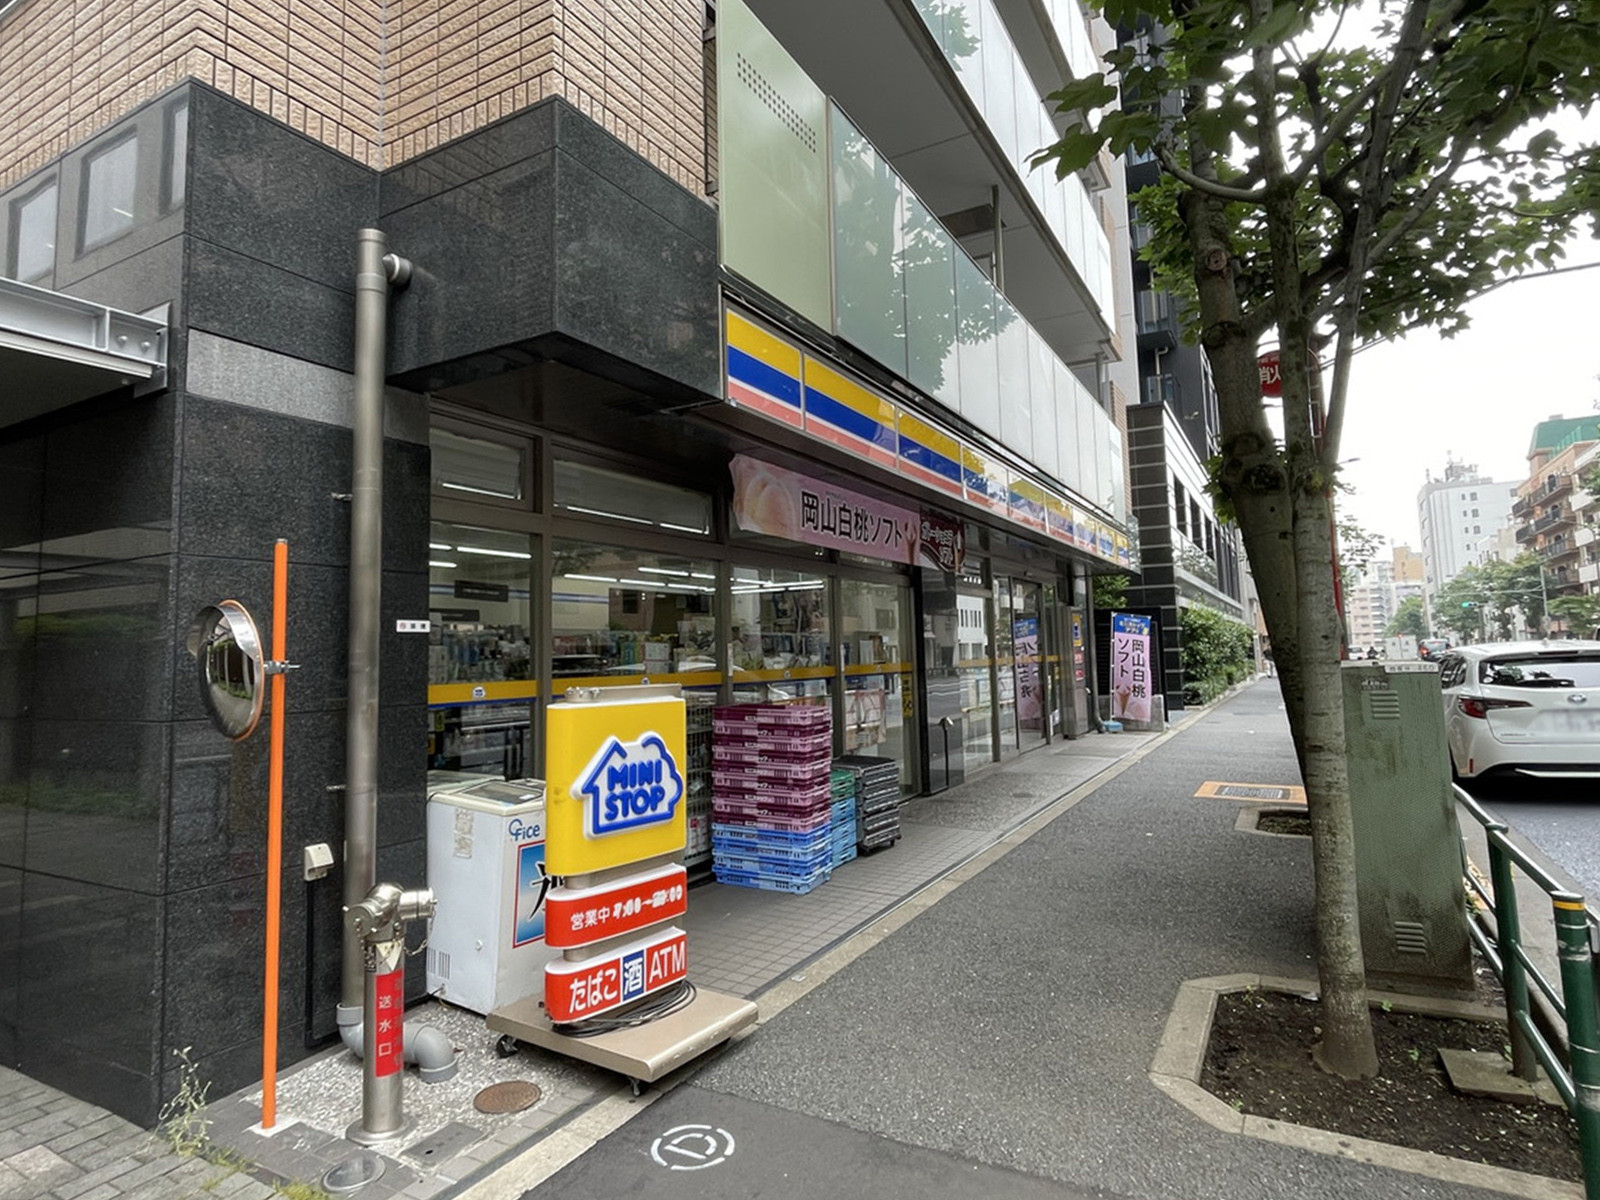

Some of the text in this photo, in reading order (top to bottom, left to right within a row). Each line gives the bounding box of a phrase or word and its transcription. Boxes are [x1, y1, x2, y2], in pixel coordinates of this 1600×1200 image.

[801, 491, 901, 548] 岡山白桃ソフト
[1118, 638, 1129, 677] ソフト
[1131, 639, 1146, 698] 岡山白桃
[607, 759, 662, 791] MINI
[605, 785, 665, 821] STOP
[571, 907, 610, 931] 営業中
[569, 941, 685, 1013] たばこ 酒 ATM
[379, 995, 392, 1056] 送水口
